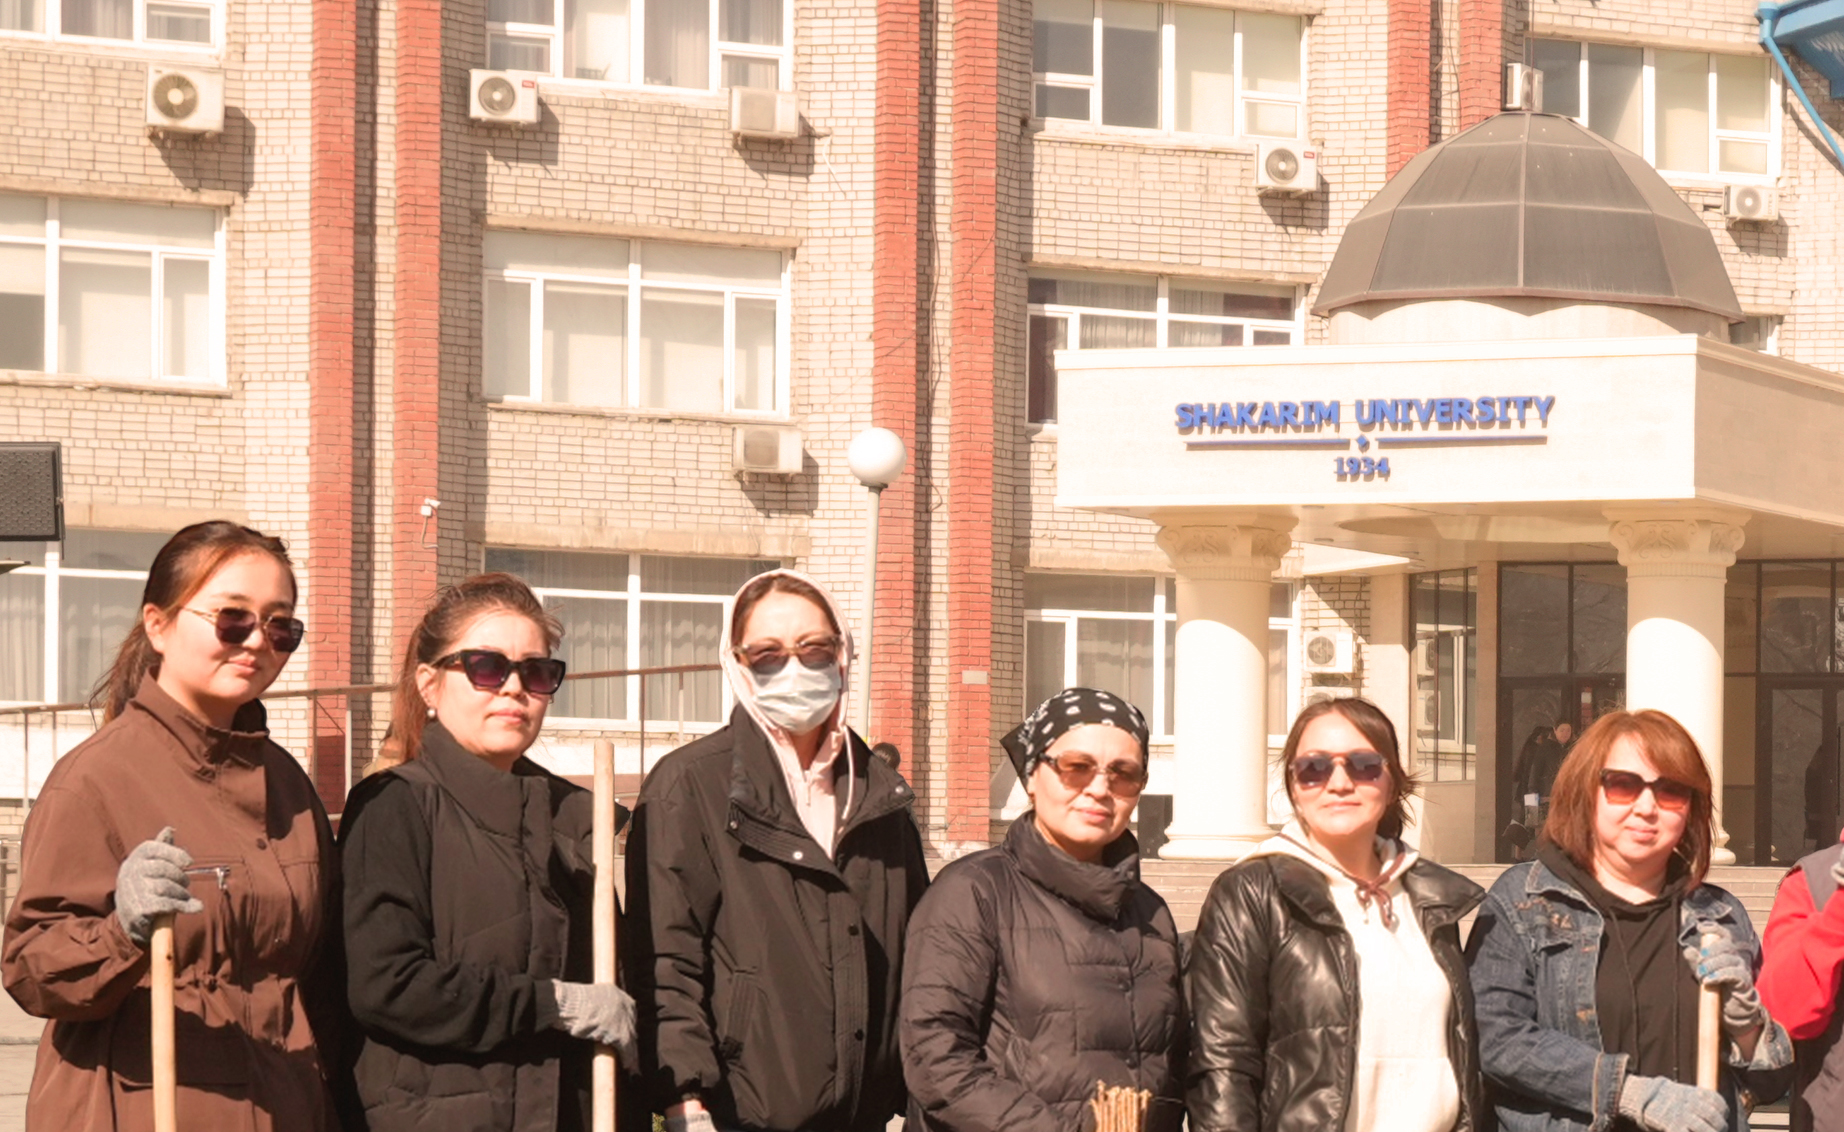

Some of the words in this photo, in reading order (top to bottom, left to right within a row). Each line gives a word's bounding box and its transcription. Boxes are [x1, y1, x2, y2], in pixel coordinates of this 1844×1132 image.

[1175, 400, 1340, 429] SHAKARIM
[1355, 395, 1556, 425] UNIVERSITY
[1334, 456, 1390, 477] 1934
